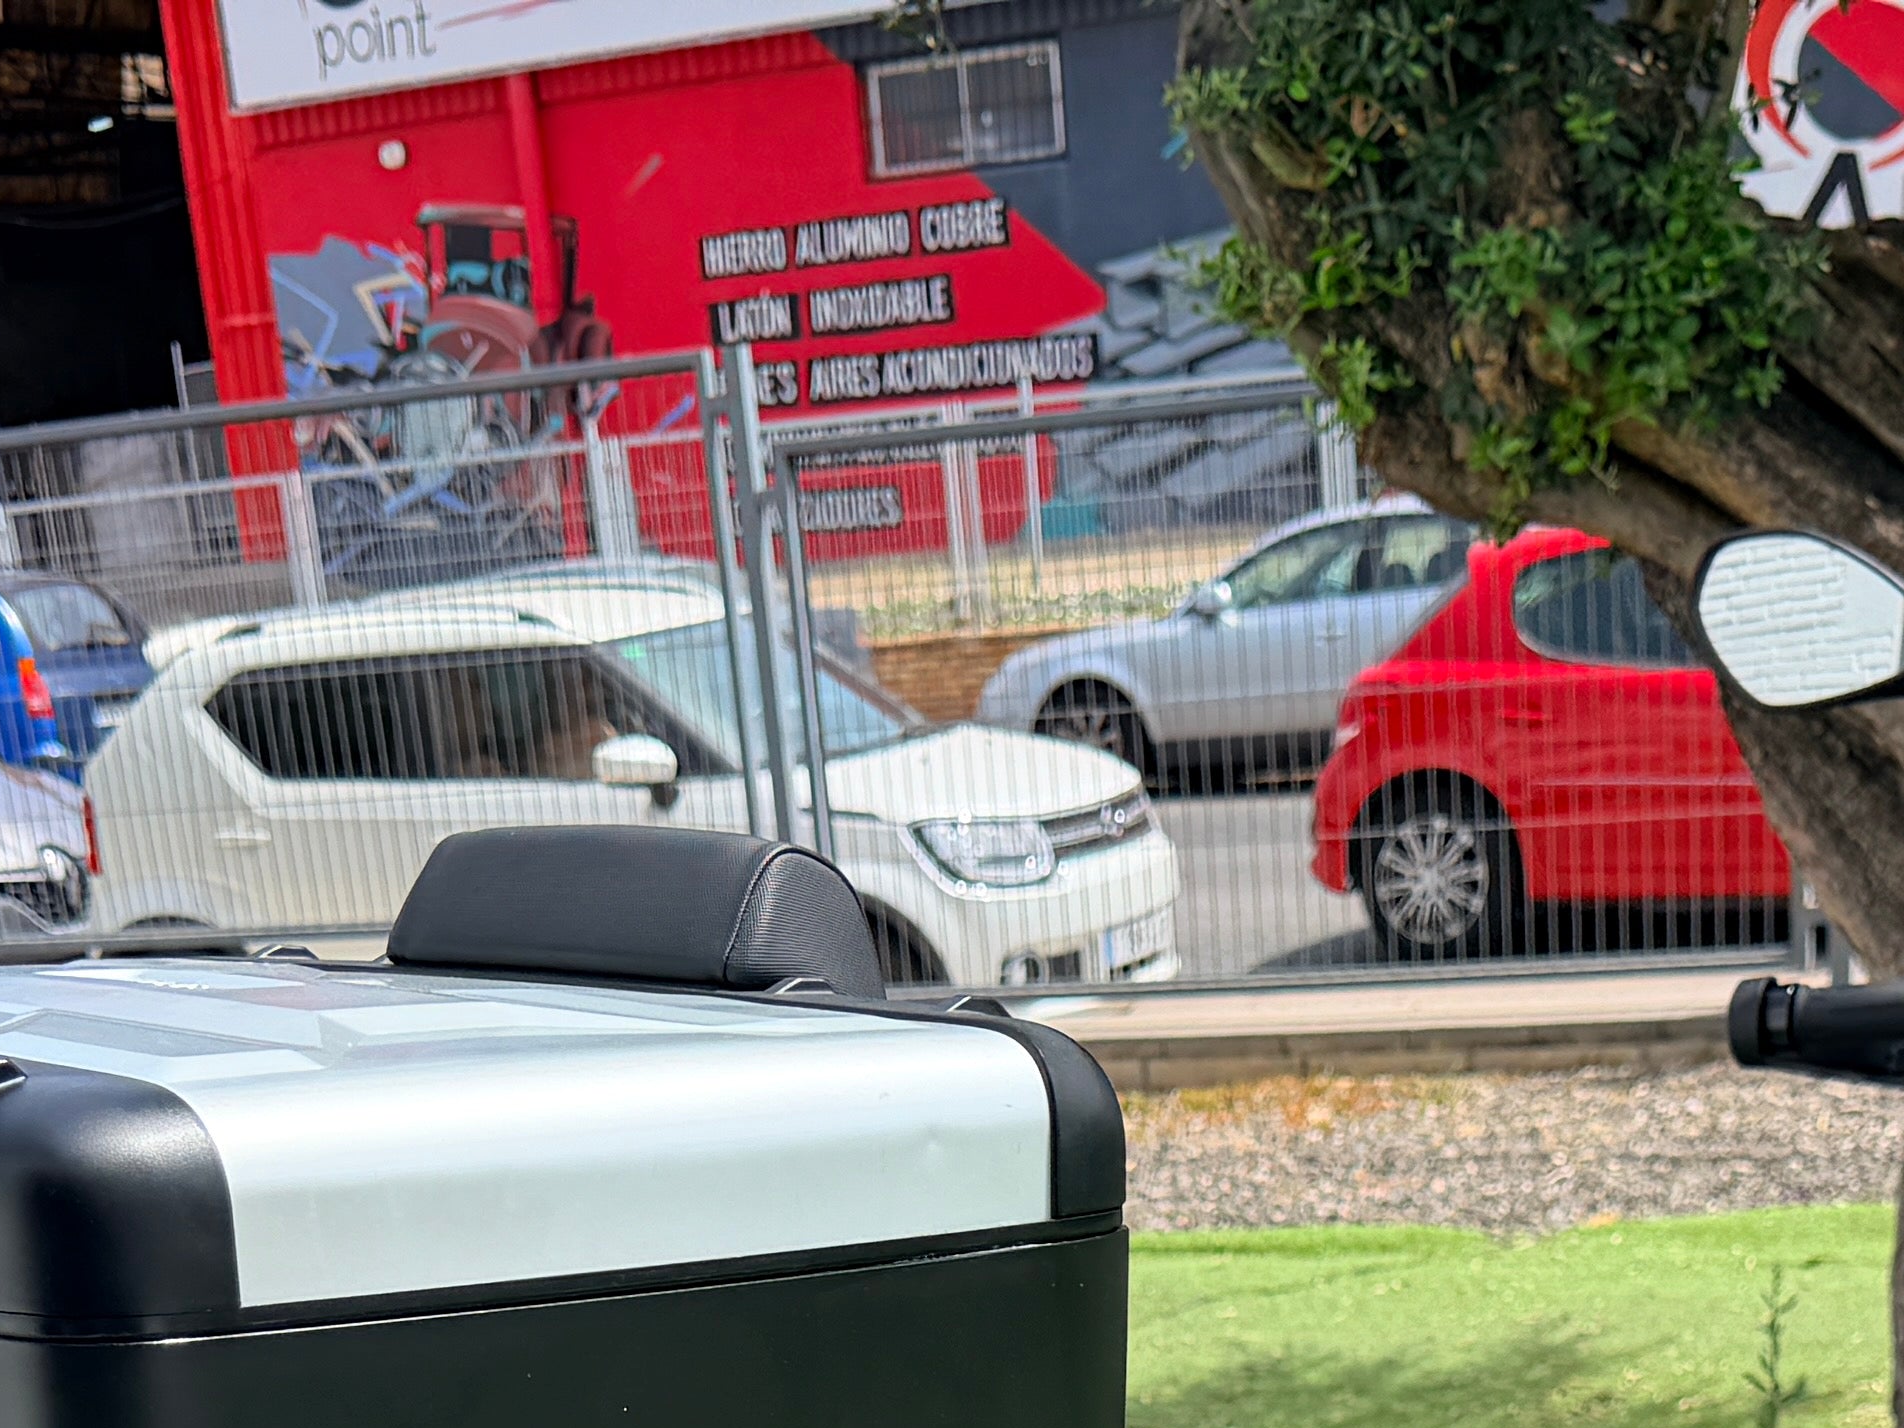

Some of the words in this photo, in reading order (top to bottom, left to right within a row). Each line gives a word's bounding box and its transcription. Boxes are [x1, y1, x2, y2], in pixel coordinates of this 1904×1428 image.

[313, 0, 437, 82] point
[702, 227, 787, 278] HIERRO
[796, 210, 911, 268] ALUMINIO
[919, 198, 1006, 252] COBRE
[809, 274, 951, 333] INOXIDABLE
